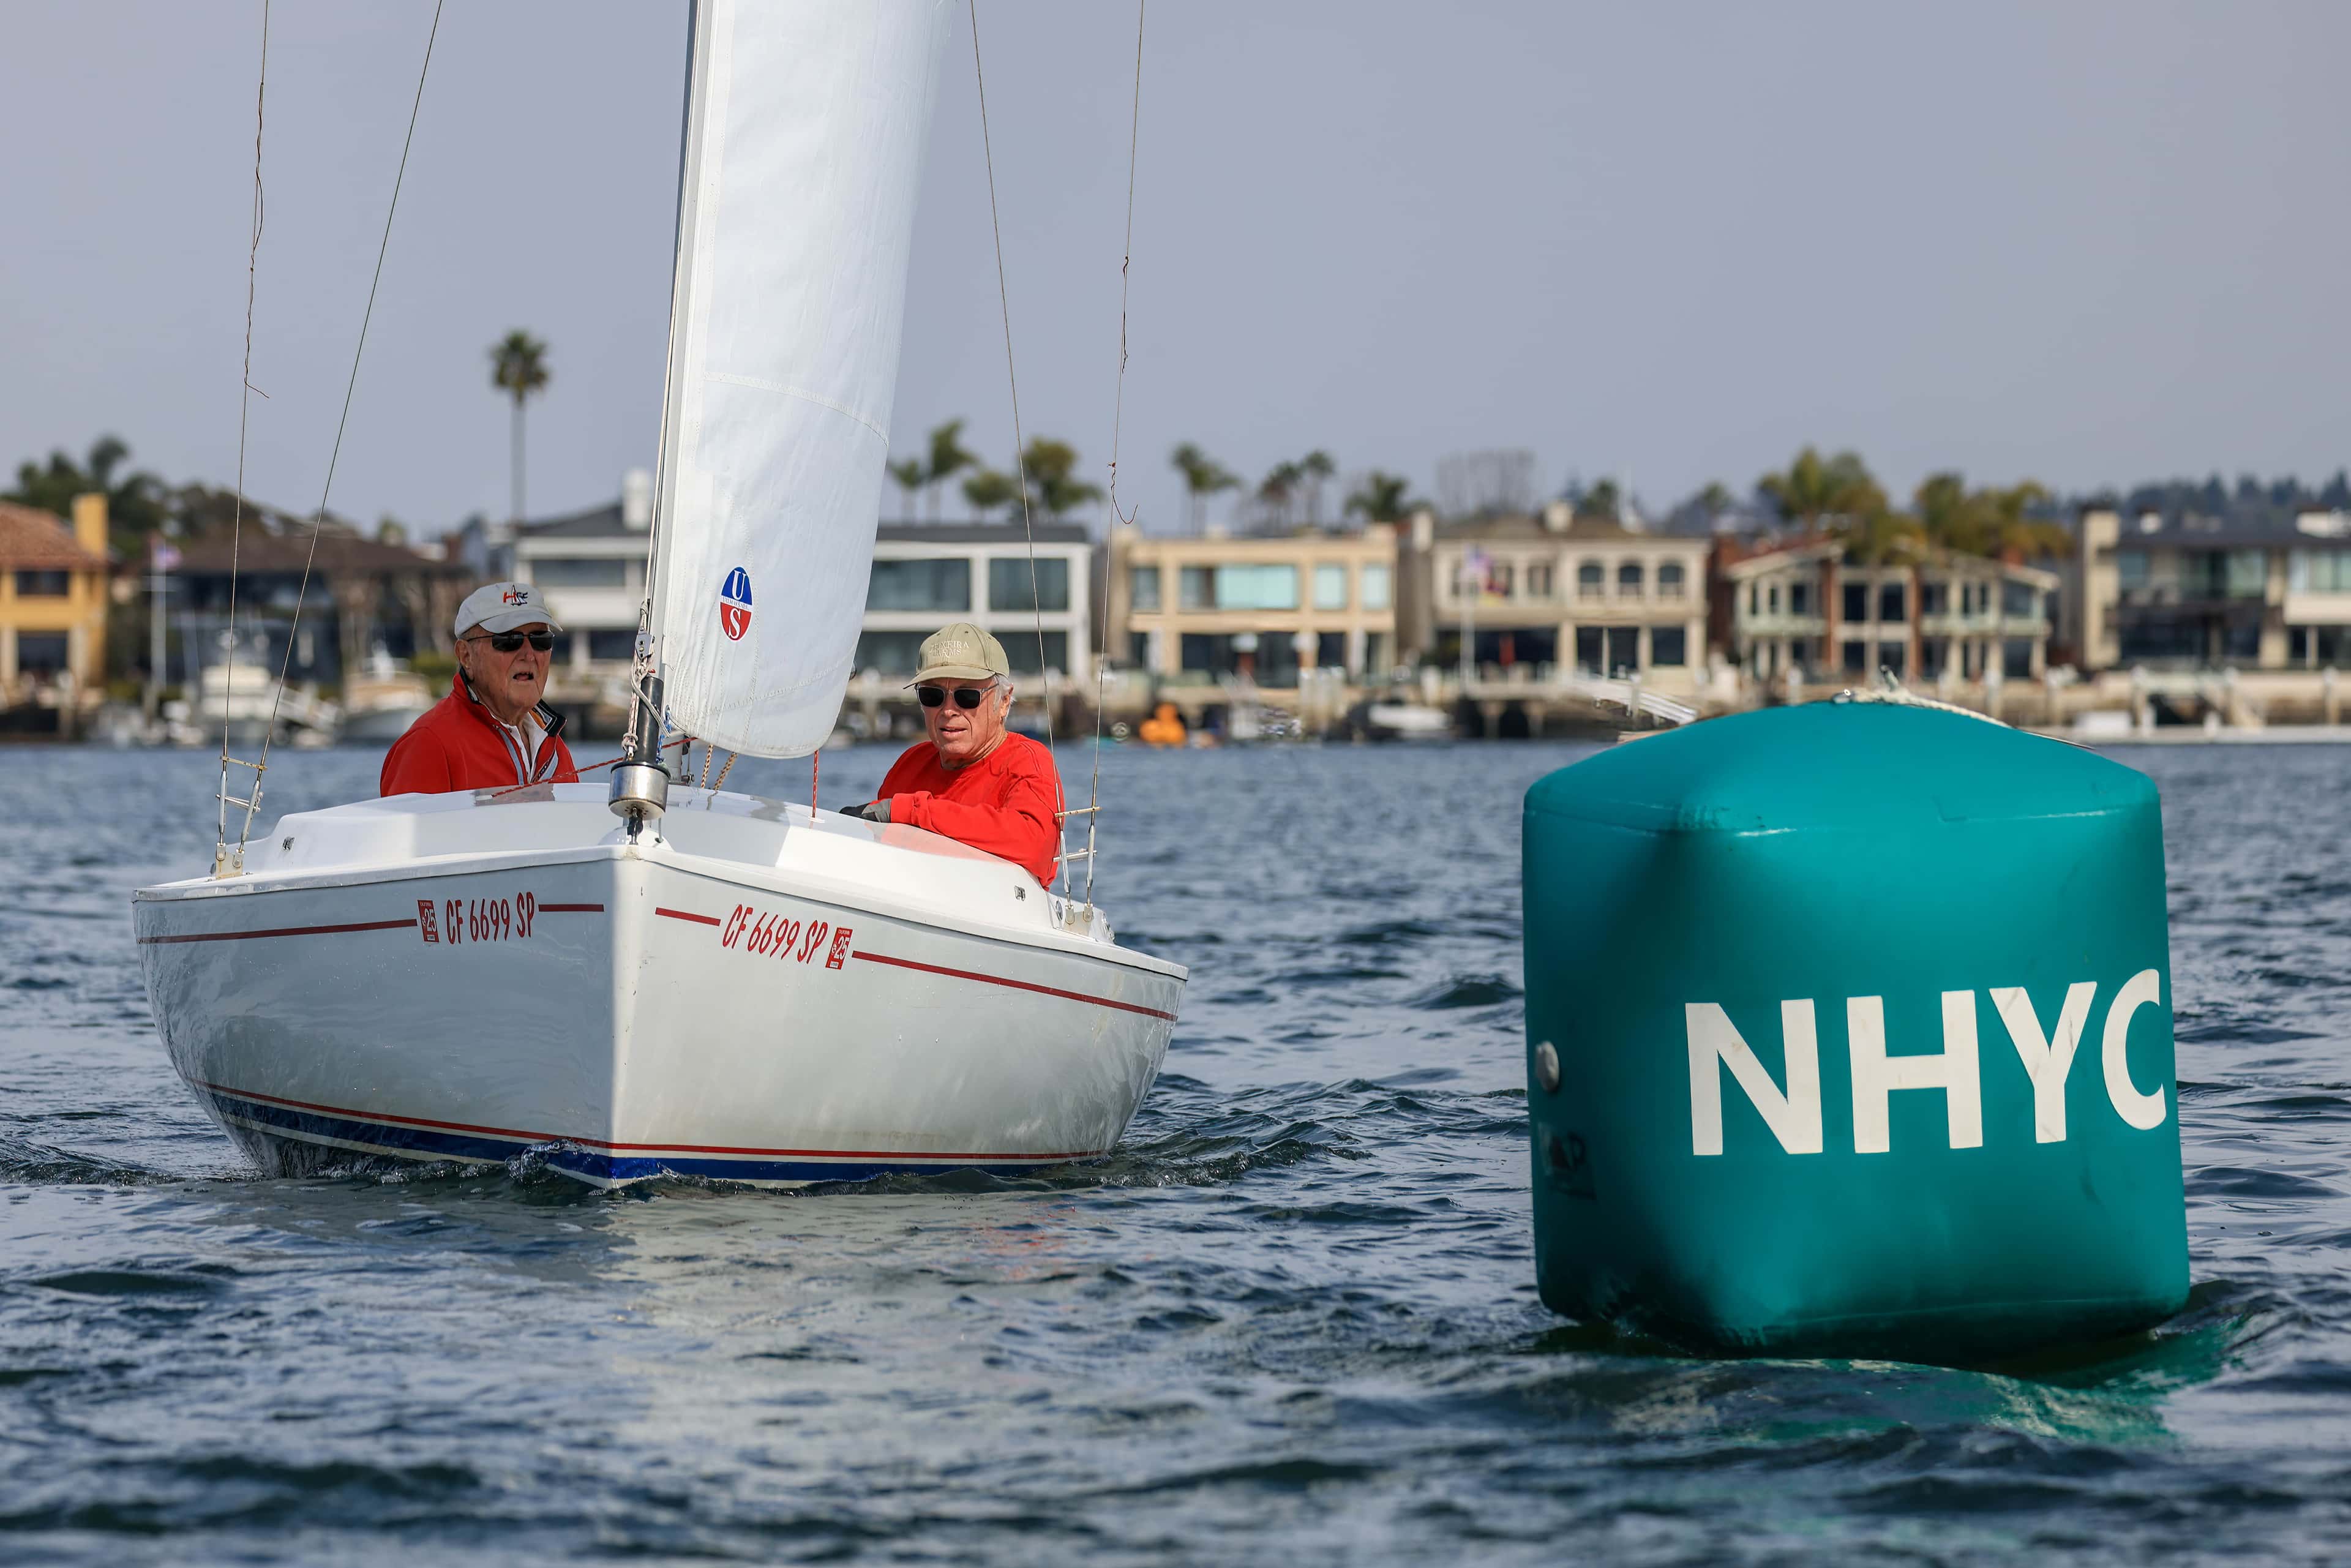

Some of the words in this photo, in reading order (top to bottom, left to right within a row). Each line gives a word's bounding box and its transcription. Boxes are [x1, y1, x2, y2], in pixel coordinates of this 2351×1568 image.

[732, 570, 746, 600] U
[728, 608, 741, 639] S
[425, 908, 437, 932] 25
[446, 899, 463, 945] CF
[470, 898, 510, 942] 6699
[517, 891, 534, 938] SP
[722, 904, 754, 949] CF
[748, 912, 800, 960] 6699
[797, 920, 828, 964] SP
[834, 936, 850, 960] 25
[1685, 969, 2167, 1155] NHYC
